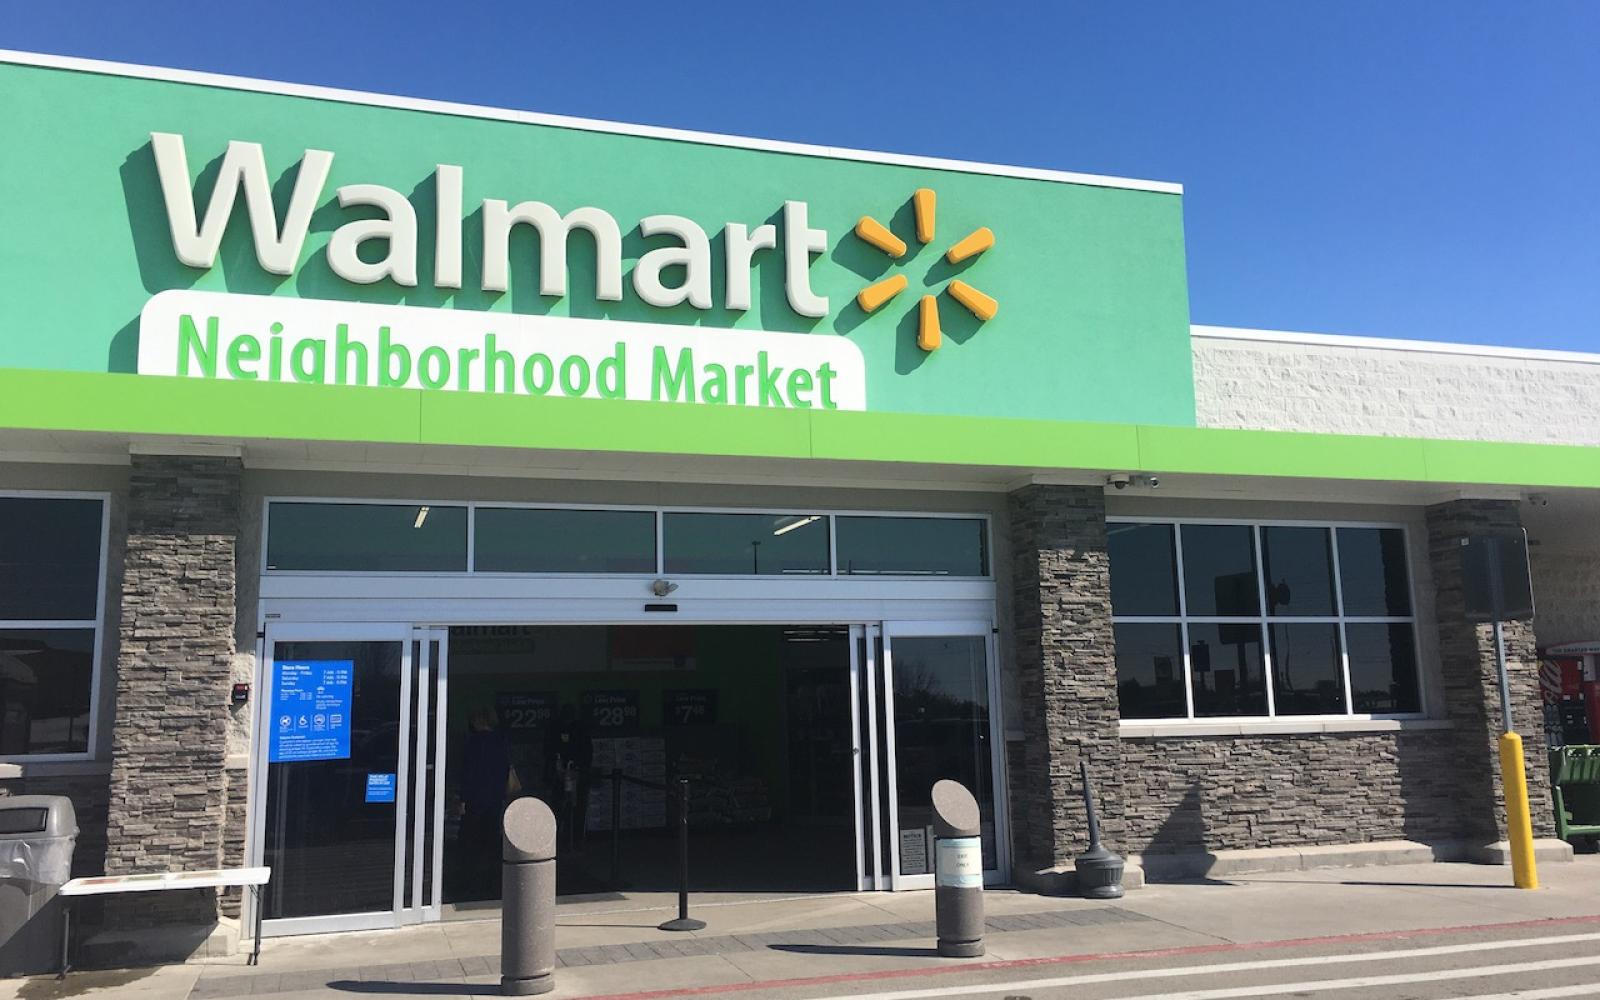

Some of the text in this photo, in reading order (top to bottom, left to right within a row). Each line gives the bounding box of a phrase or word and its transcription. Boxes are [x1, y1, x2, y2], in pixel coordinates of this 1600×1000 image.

[150, 132, 830, 318] Walmart
[176, 314, 838, 409] Neighborhood Market
